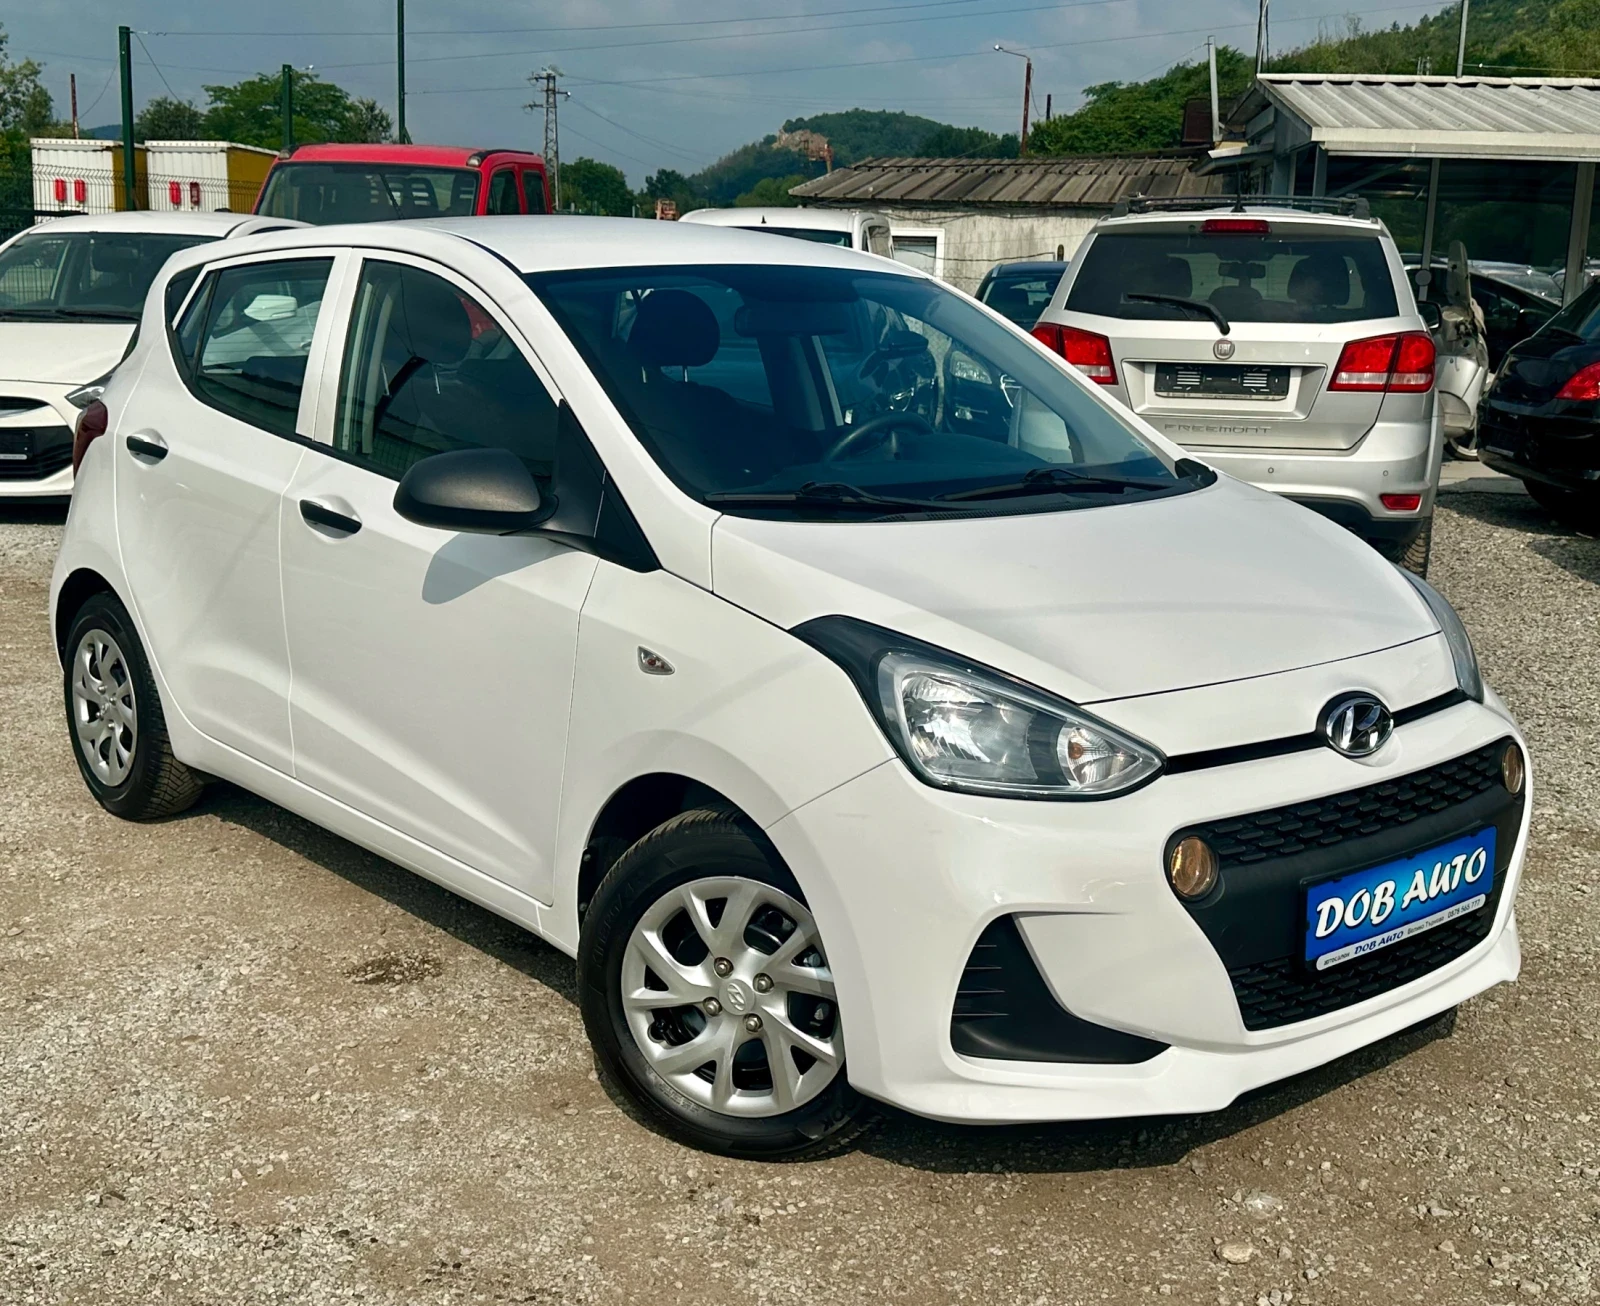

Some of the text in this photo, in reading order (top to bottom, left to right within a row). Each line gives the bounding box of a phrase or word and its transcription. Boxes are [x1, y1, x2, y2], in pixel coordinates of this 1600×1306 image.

[1164, 423, 1272, 434] FREEMONT
[1315, 847, 1487, 938] DOB AUTO
[1354, 941, 1377, 955] DOB
[1378, 931, 1404, 947] AUTO
